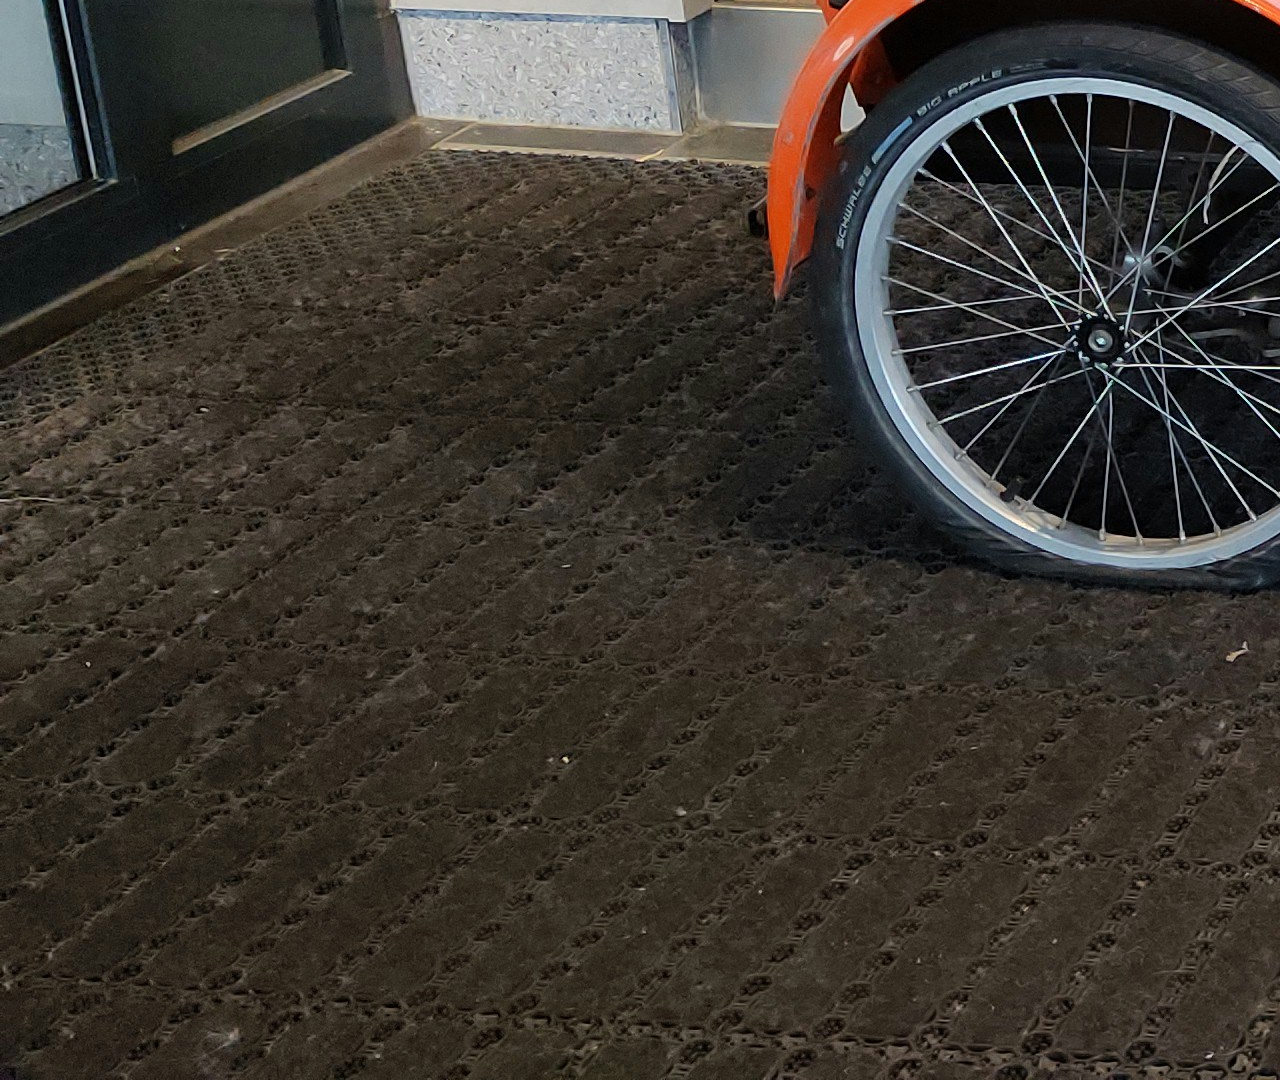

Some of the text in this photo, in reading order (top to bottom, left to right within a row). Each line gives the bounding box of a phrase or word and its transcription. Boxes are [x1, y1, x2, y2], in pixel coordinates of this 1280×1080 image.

[836, 69, 1003, 250] SCHWALBE BIG APPLE
